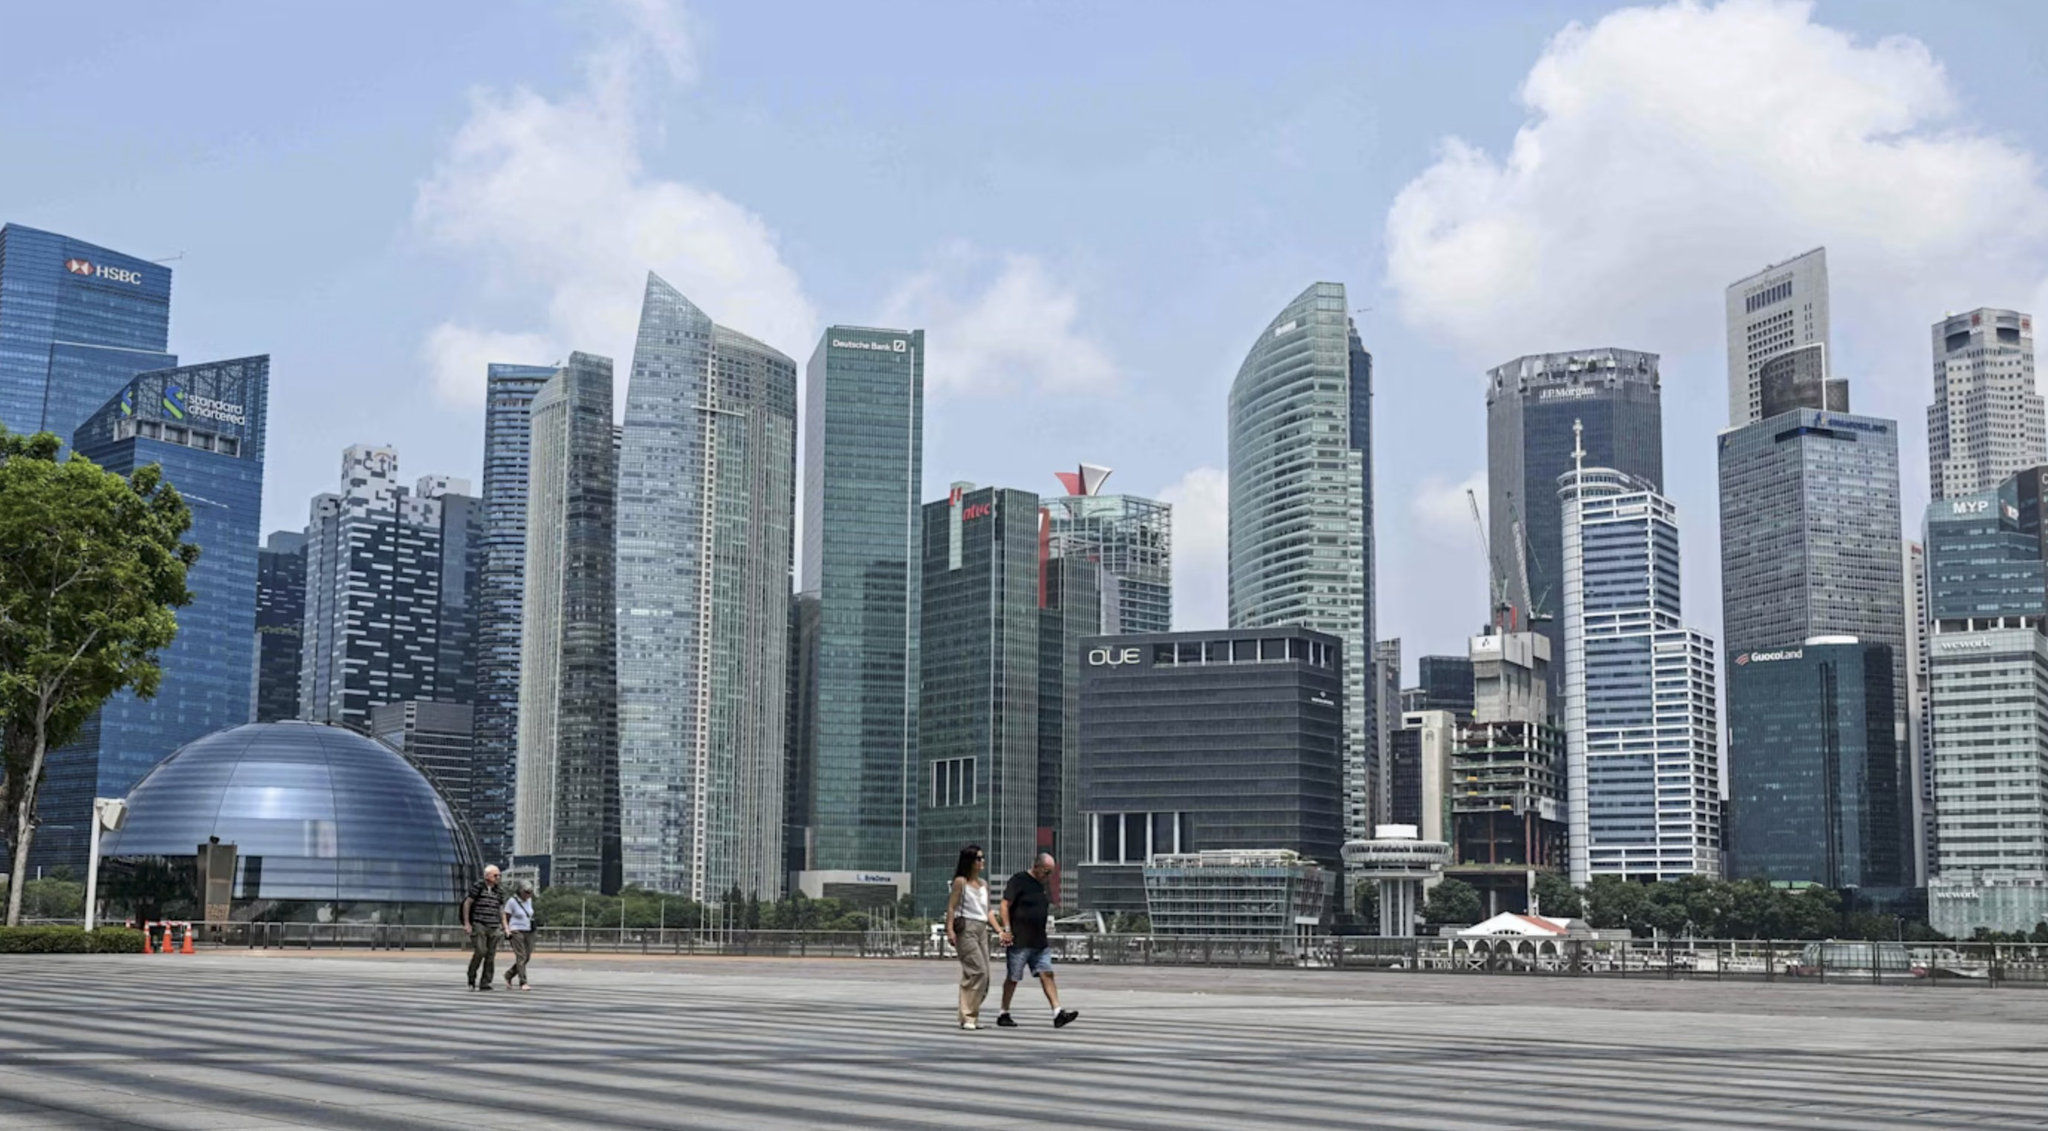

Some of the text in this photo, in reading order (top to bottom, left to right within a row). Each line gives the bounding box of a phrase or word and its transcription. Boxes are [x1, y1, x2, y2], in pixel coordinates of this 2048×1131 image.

[96, 265, 141, 284] HSBC
[832, 339, 891, 351] Deutsche Bank
[189, 394, 243, 414] standard
[188, 404, 245, 425] chartered
[1953, 500, 1988, 513] MYP
[1941, 636, 1991, 649] wework
[1088, 648, 1140, 666] OUE
[1751, 649, 1803, 662] GuocoLand
[1936, 888, 1979, 899] wework
